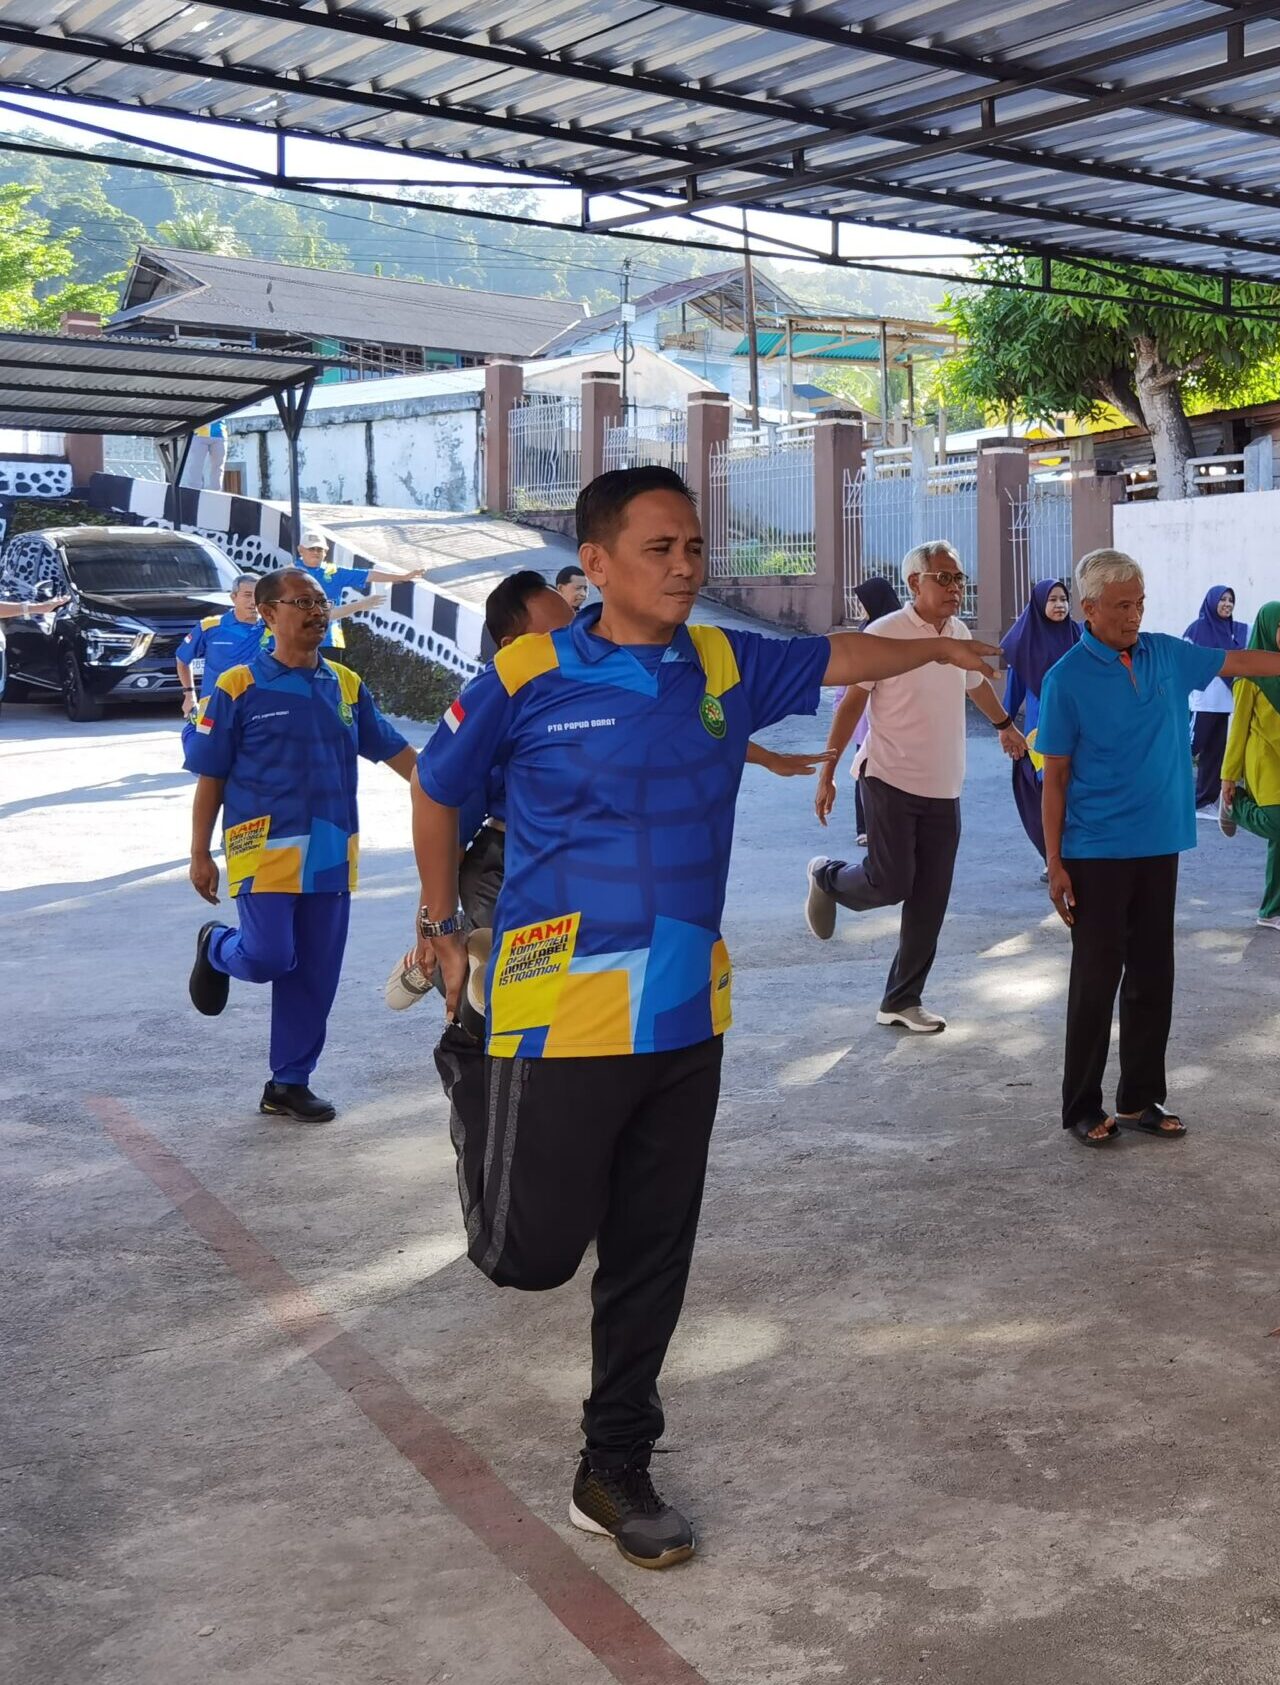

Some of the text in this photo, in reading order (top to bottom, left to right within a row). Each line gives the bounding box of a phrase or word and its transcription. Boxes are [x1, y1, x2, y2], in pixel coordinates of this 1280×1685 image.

[547, 718, 616, 733] PTA PAPUA BARAT
[511, 918, 573, 947] KAMI
[501, 956, 550, 977] MODERN
